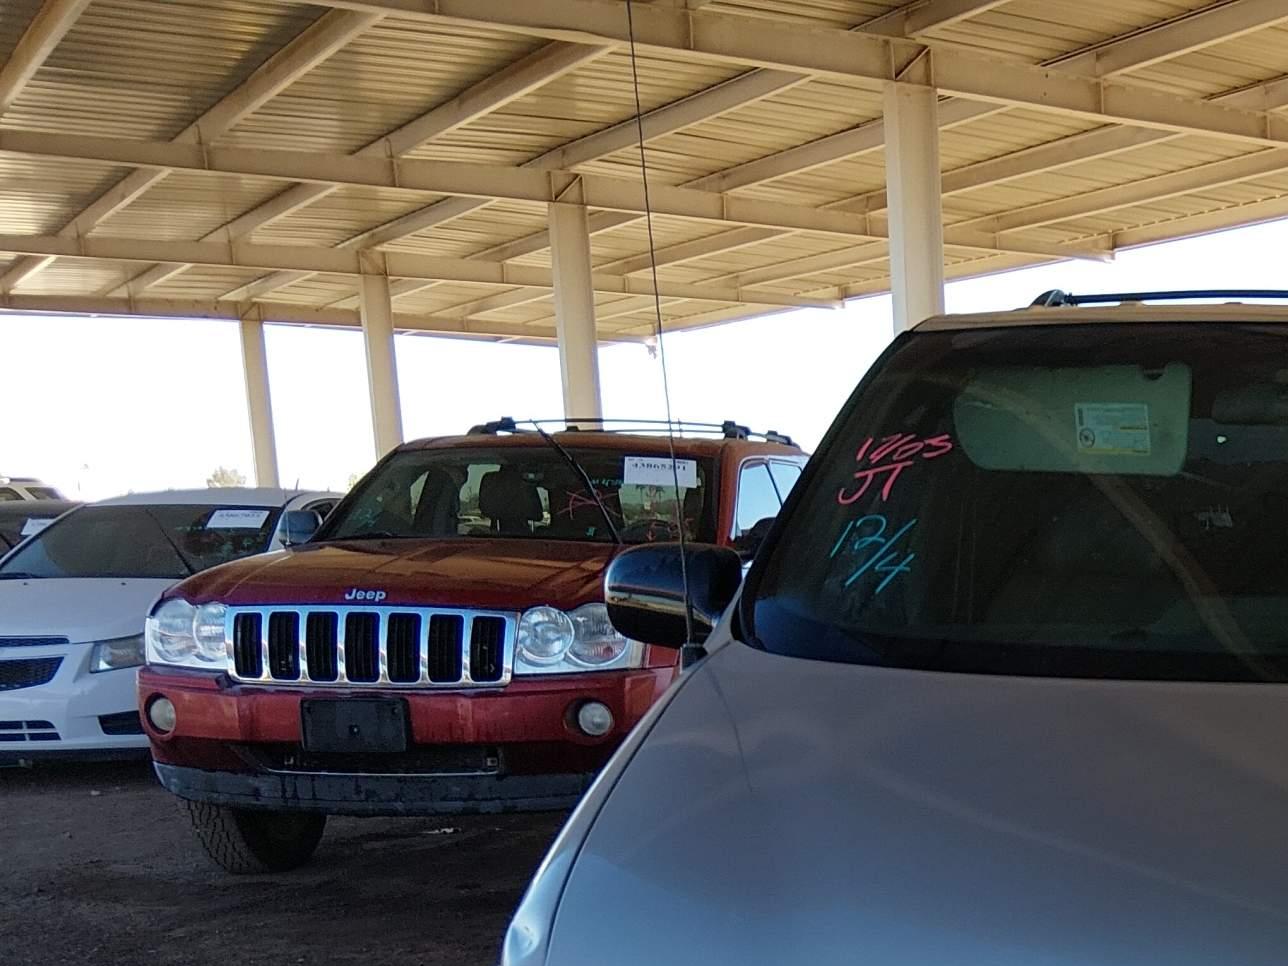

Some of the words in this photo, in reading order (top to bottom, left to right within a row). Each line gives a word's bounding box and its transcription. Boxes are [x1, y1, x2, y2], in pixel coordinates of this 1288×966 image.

[838, 460, 914, 505] JT
[830, 514, 917, 594] 12/4
[345, 588, 386, 602] Jeep
